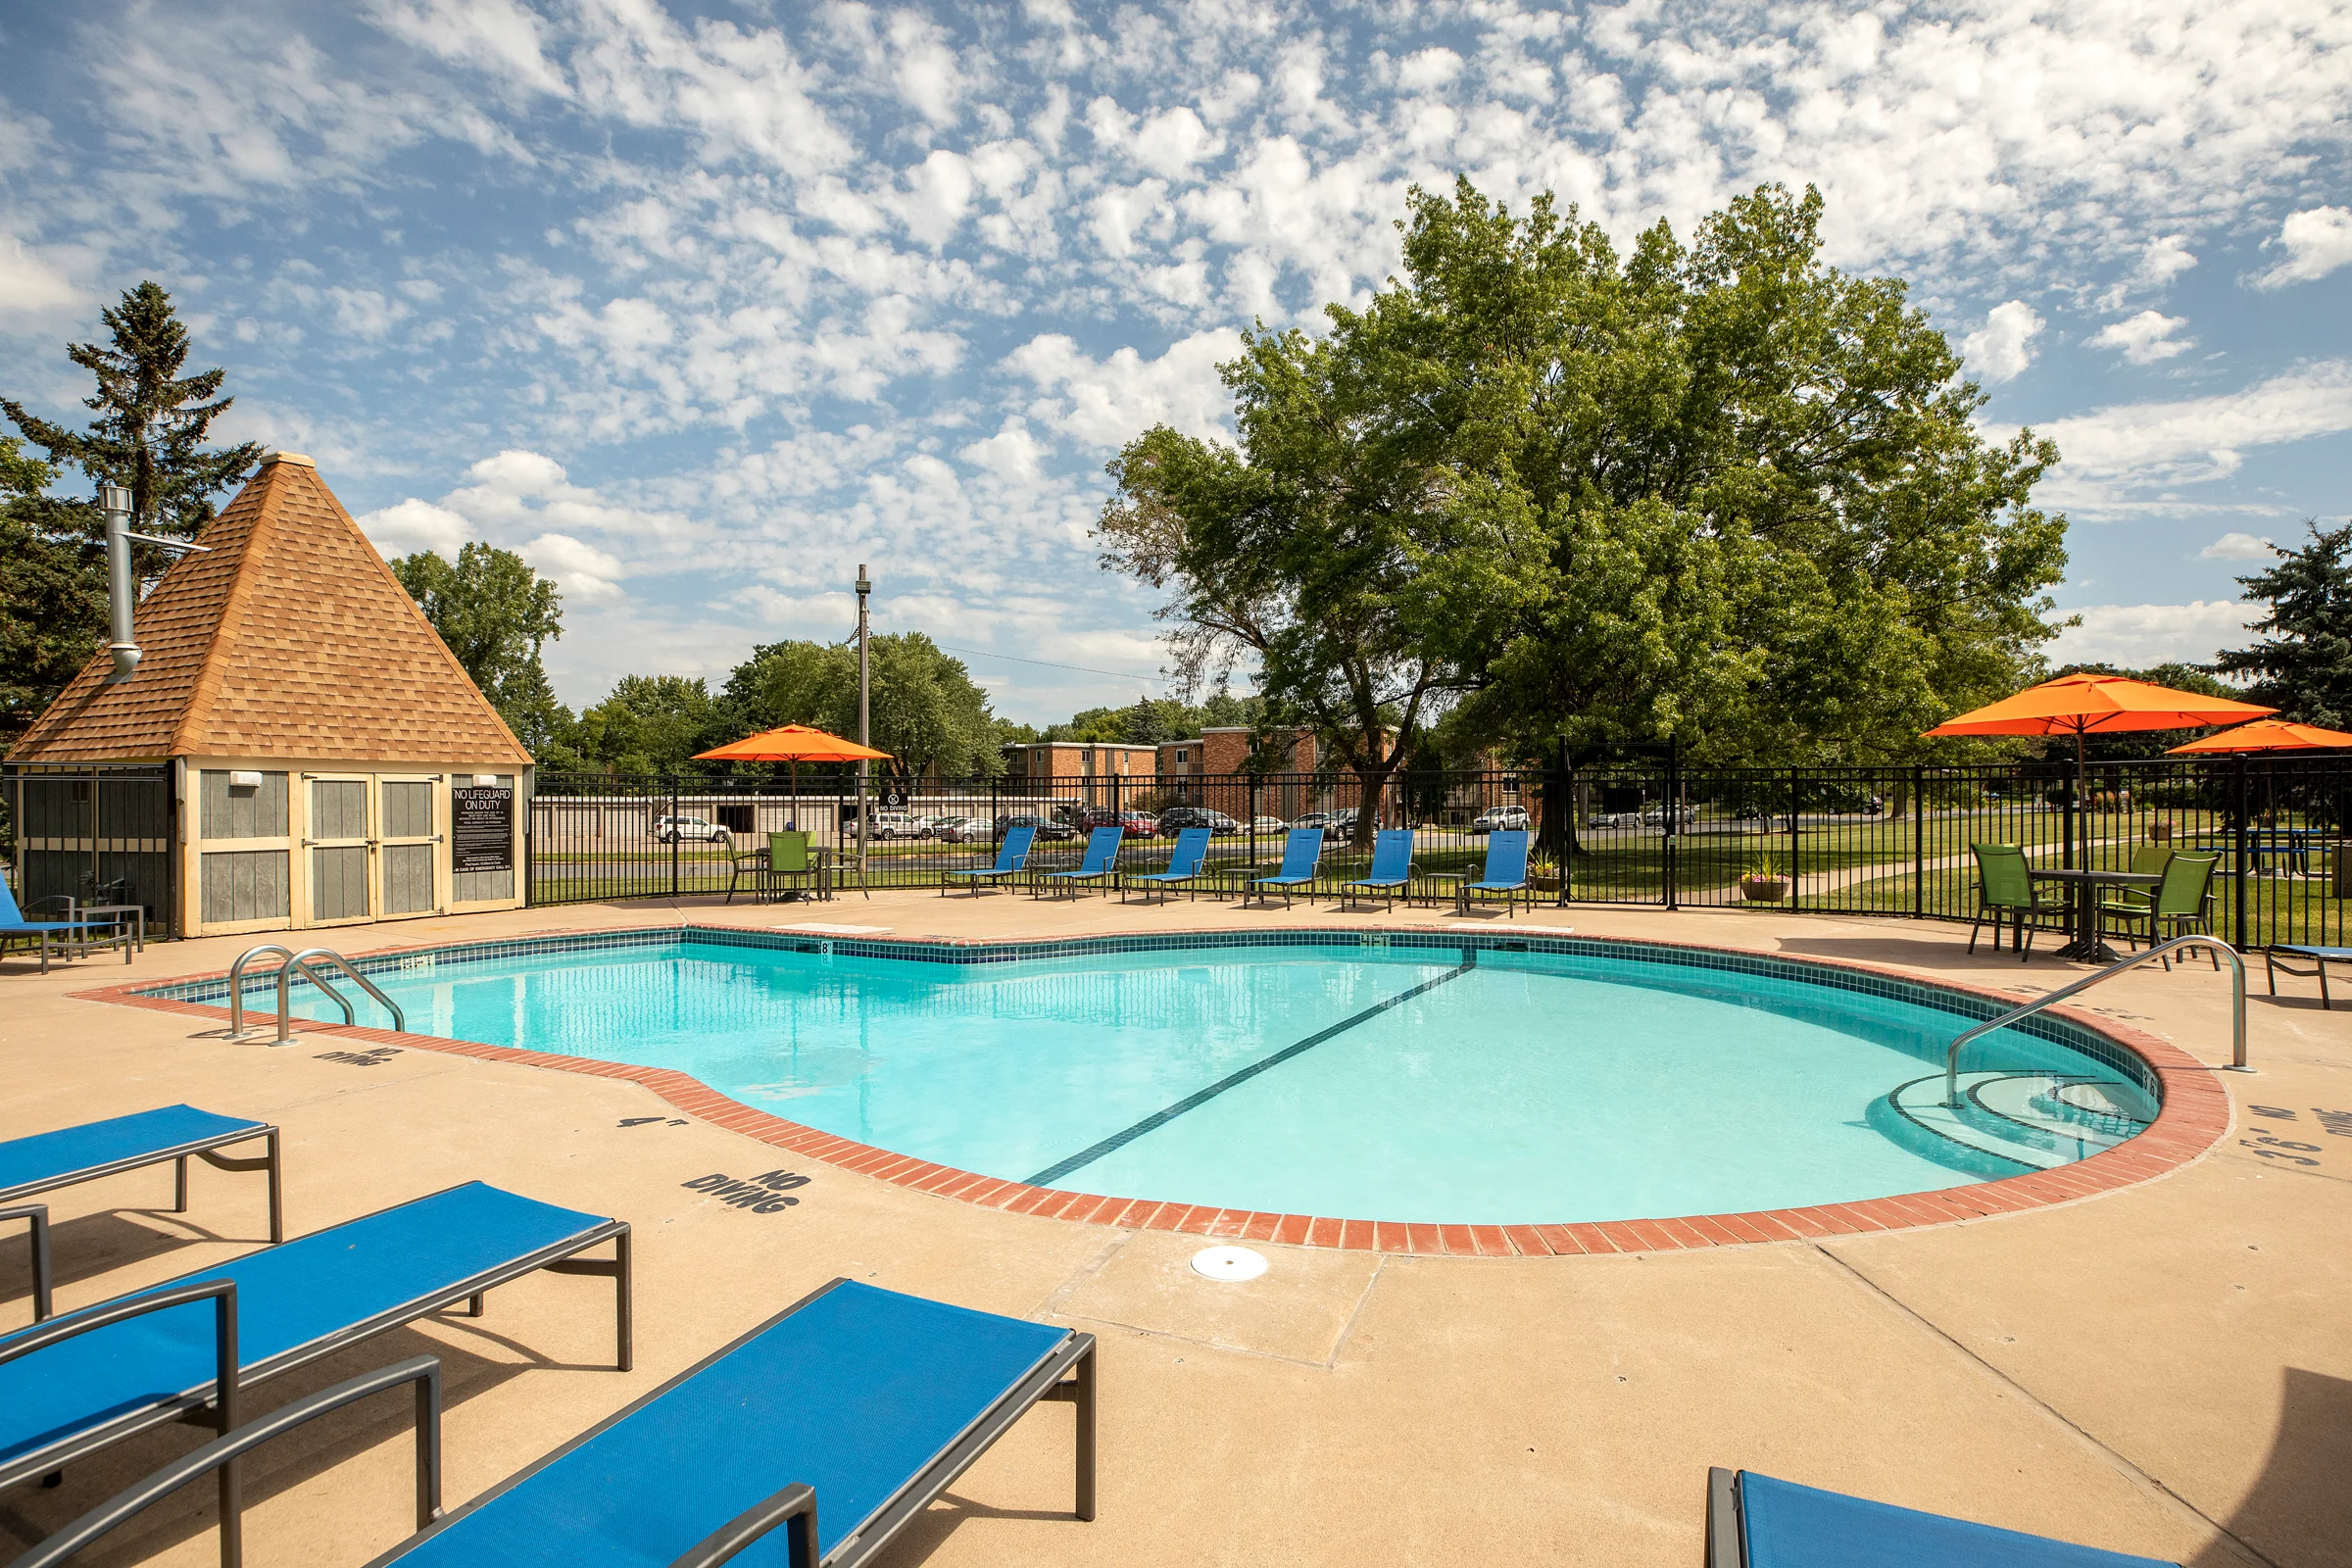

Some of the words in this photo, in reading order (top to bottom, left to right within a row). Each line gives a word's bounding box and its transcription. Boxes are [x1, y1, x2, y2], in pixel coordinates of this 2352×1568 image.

[455, 789, 467, 800] NO
[468, 789, 511, 800] LIFEGUARD
[466, 800, 478, 809] ON
[478, 800, 501, 809] DUTY
[822, 943, 828, 954] 8
[2247, 1103, 2300, 1122] NO
[615, 1116, 666, 1128] 4
[748, 1169, 811, 1191] NO
[680, 1173, 800, 1214] DIVING
